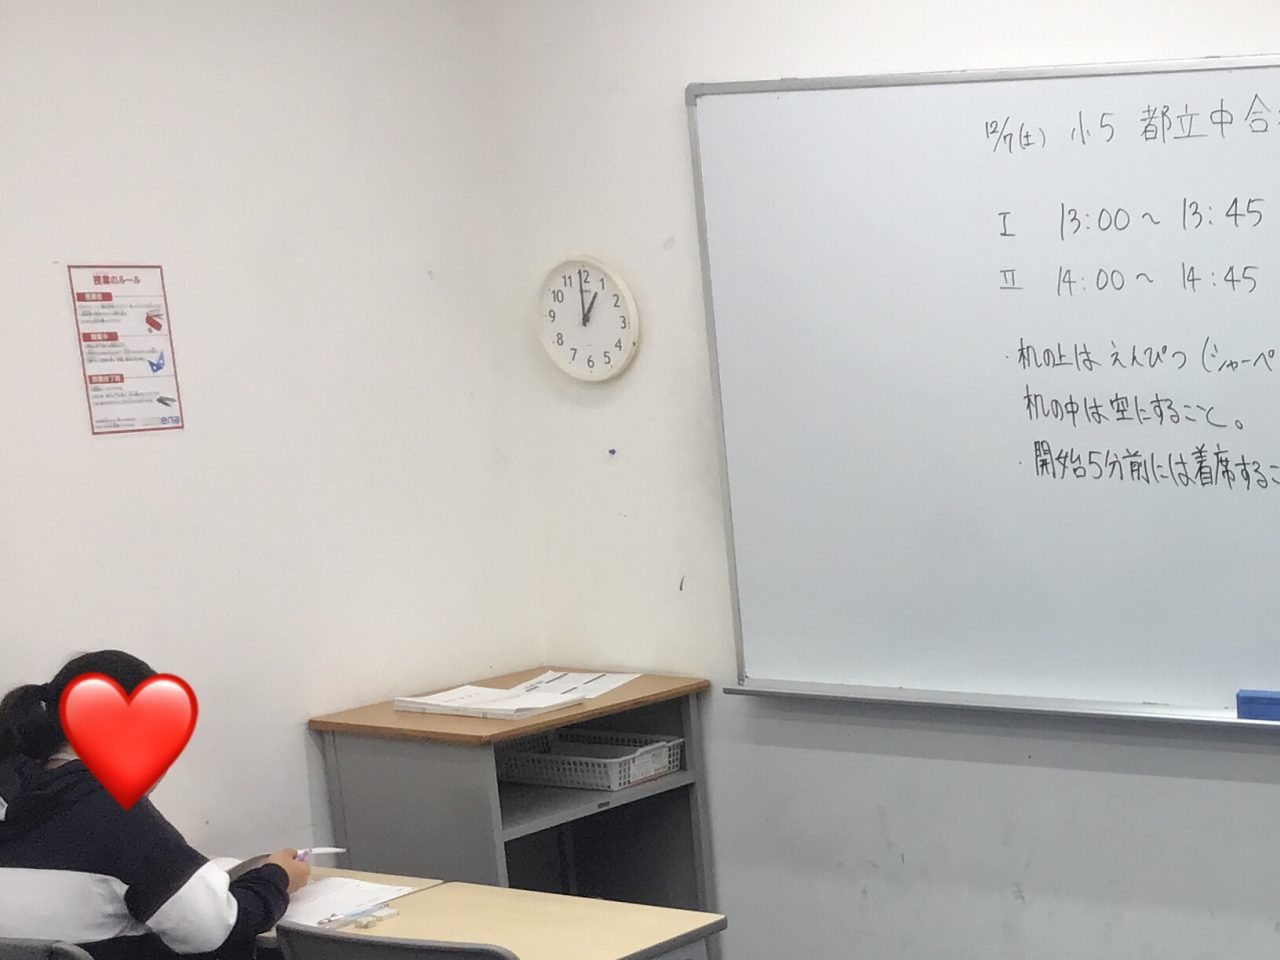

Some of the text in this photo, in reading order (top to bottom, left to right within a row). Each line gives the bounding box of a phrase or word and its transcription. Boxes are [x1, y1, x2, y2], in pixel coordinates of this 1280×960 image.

[562, 274, 573, 288] 11
[600, 277, 605, 290] 1
[552, 289, 564, 303] 10
[612, 293, 621, 308] 2
[548, 308, 556, 323] 9
[619, 315, 627, 329] 3
[556, 332, 564, 346] 8
[614, 338, 622, 351] 4
[569, 348, 578, 361] 7
[603, 351, 611, 364] 5
[587, 355, 595, 369] 6
